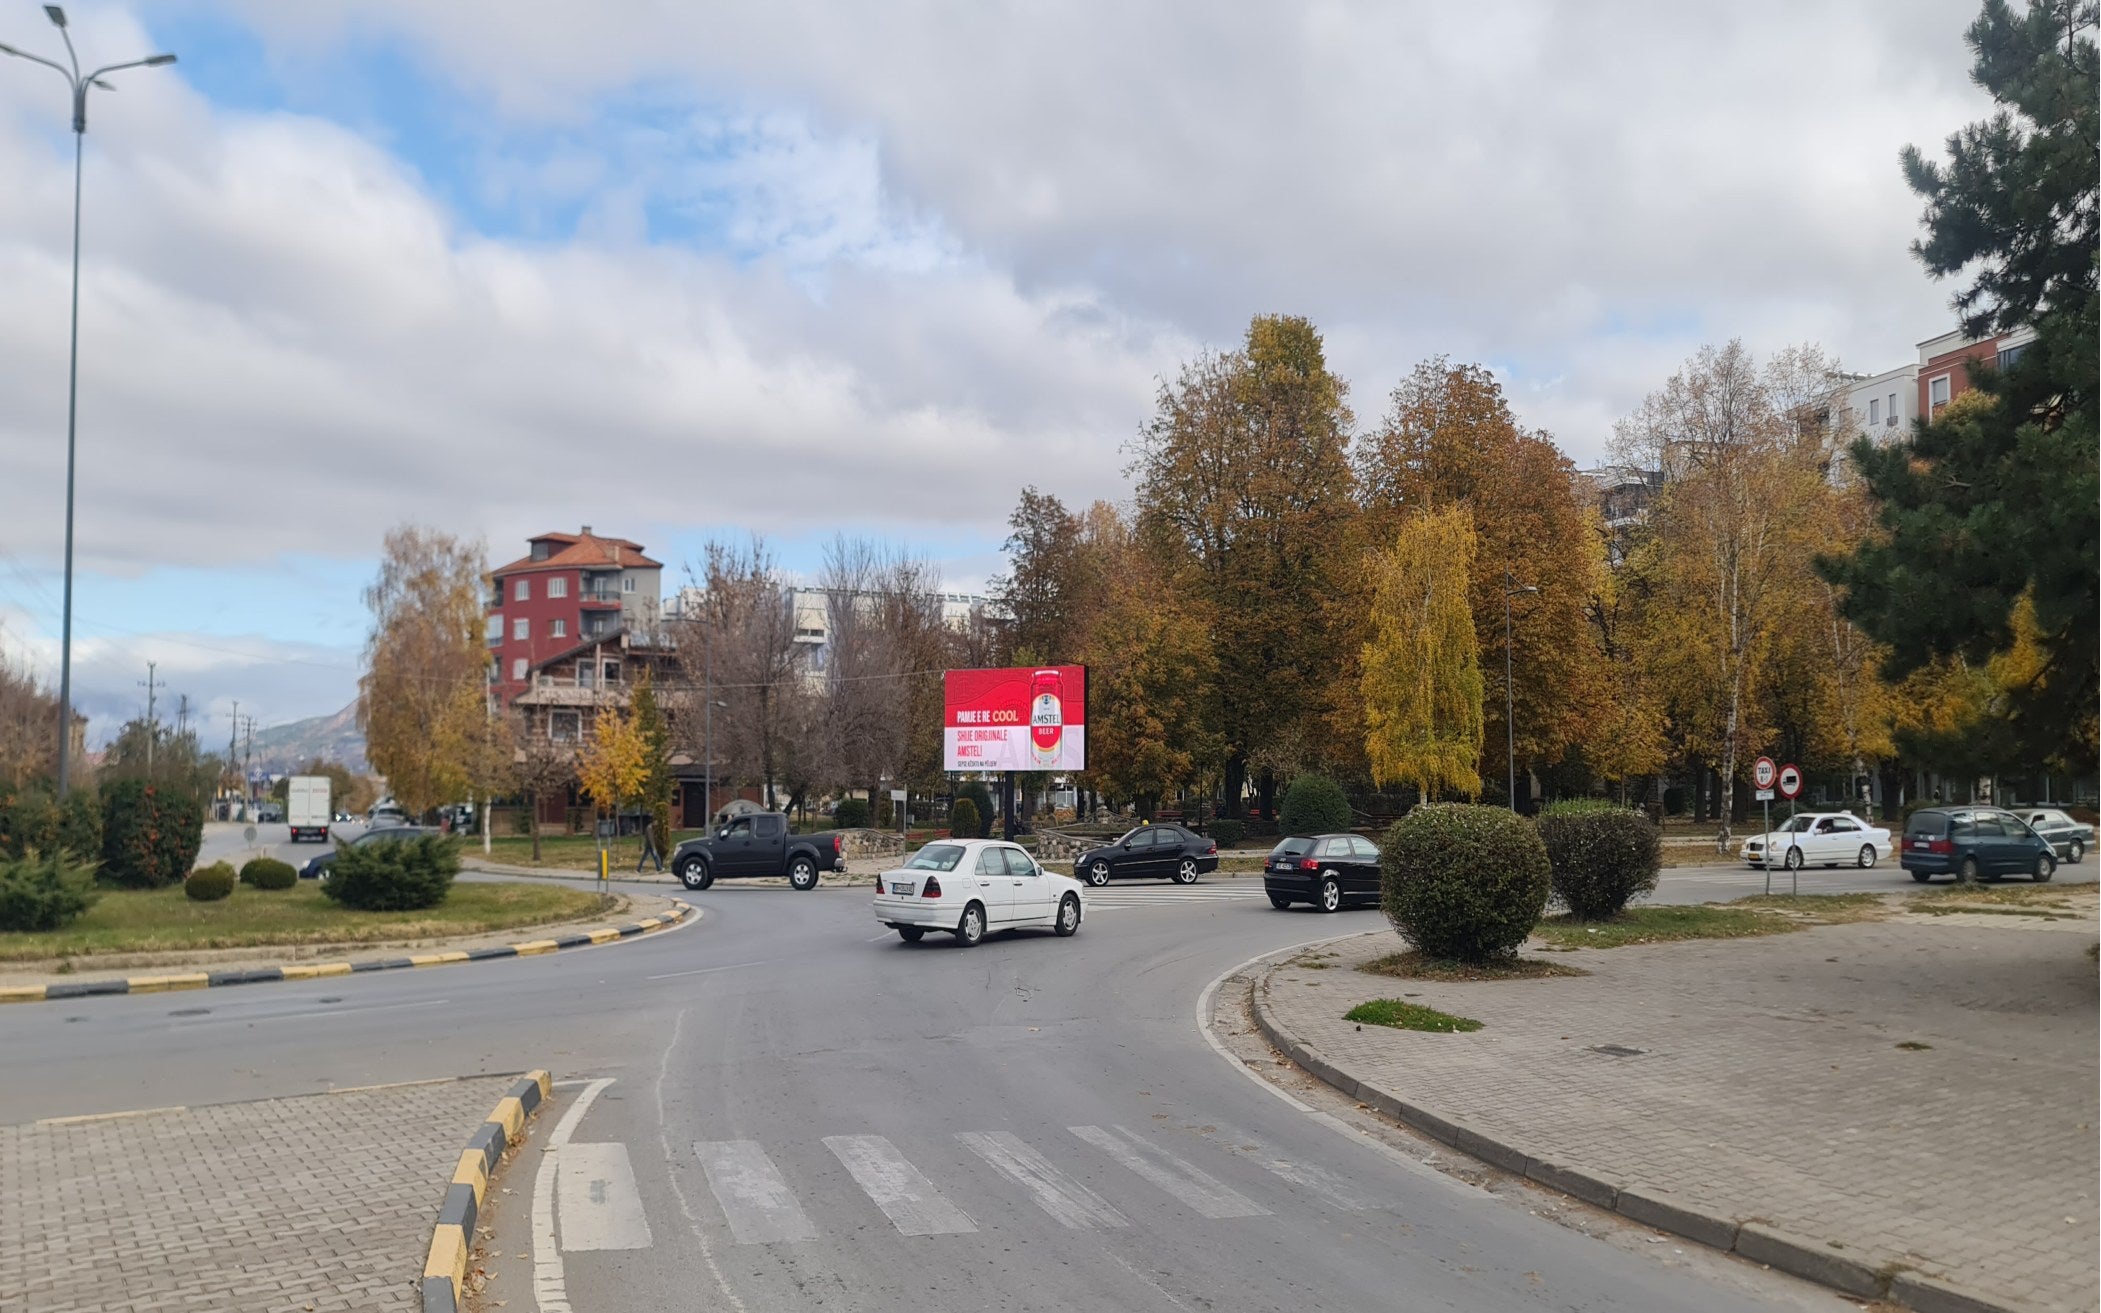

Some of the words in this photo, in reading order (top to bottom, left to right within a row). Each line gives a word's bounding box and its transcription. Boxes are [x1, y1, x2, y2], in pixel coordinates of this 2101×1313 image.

[957, 710, 976, 723] PAMJE
[982, 710, 990, 723] RE
[992, 710, 1018, 722] COOL
[1033, 714, 1060, 724] AMSTEL
[1038, 727, 1054, 735] BEER
